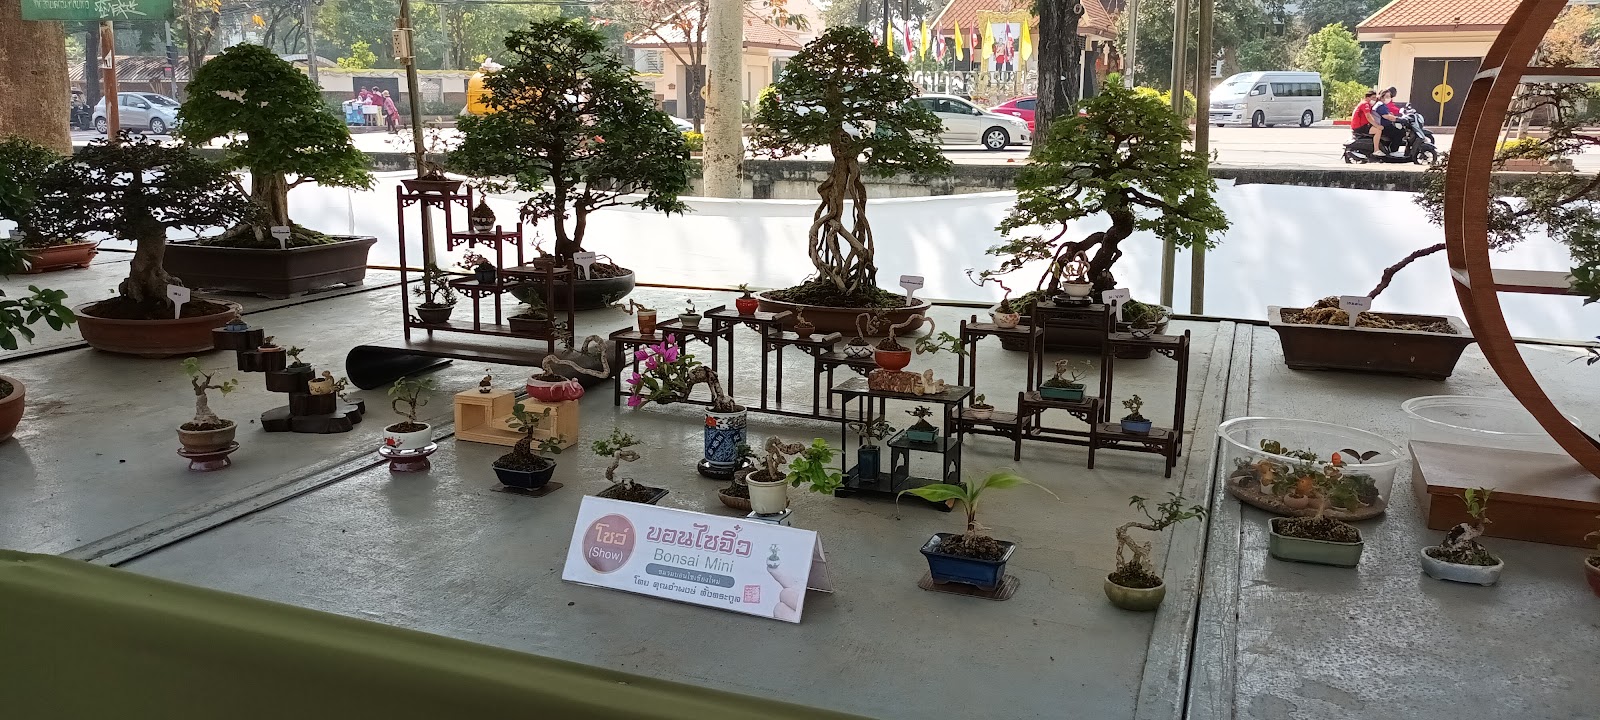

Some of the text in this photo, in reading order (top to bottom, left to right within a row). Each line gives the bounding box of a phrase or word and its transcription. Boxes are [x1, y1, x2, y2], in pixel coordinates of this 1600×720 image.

[595, 523, 629, 546] โชว์
[646, 522, 752, 556] บอนไซจิ๋ว
[588, 546, 623, 563] (Show)
[653, 548, 735, 573] Bonsai Mini
[634, 575, 649, 586] โดย
